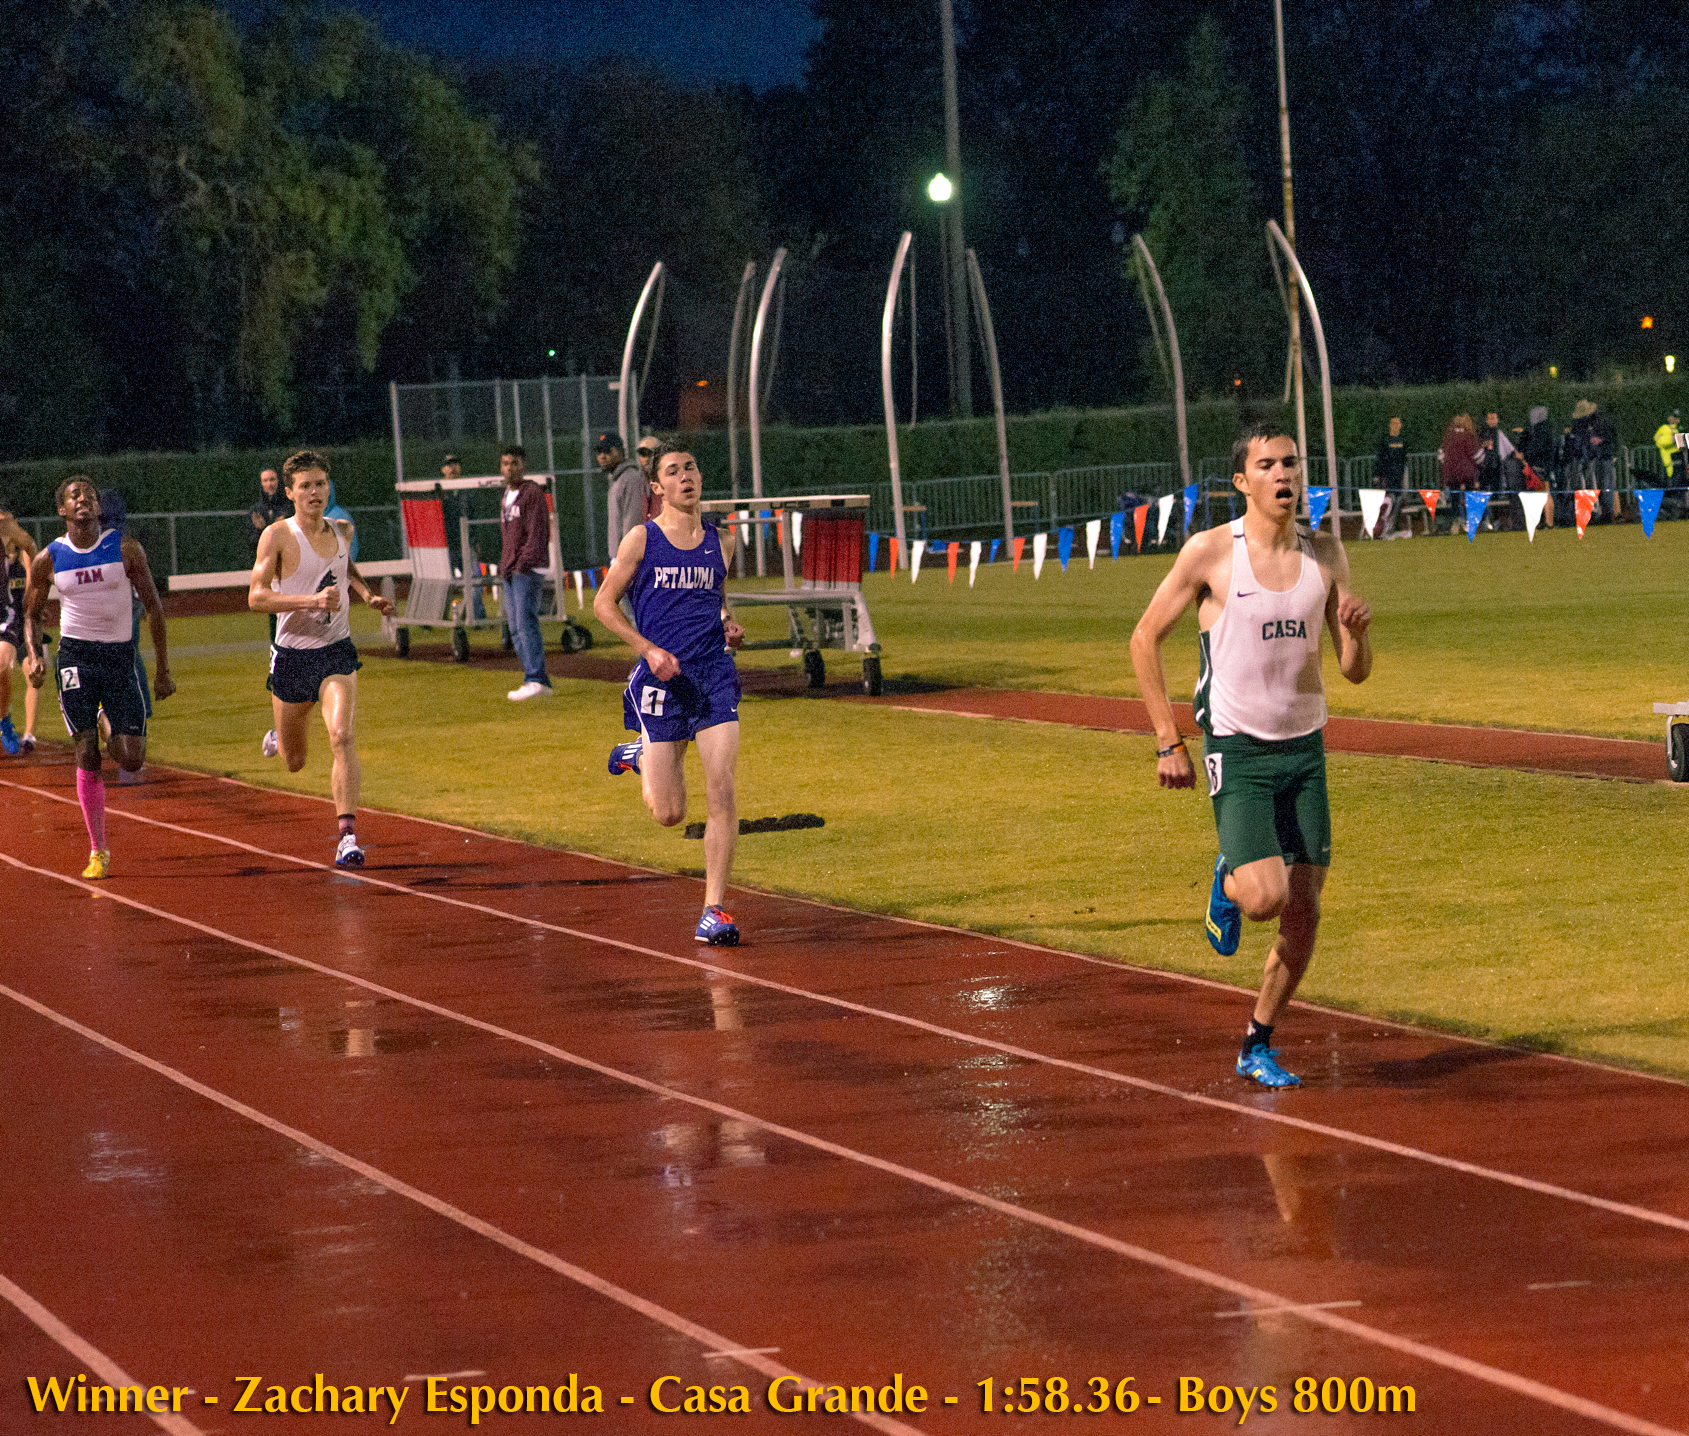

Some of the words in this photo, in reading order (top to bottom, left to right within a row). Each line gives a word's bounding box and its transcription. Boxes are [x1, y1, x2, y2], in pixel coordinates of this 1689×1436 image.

[75, 568, 104, 585] TAM
[654, 566, 714, 589] PETALUMA
[1262, 620, 1307, 640] CASA
[64, 669, 76, 688] 2
[648, 690, 659, 714] 1
